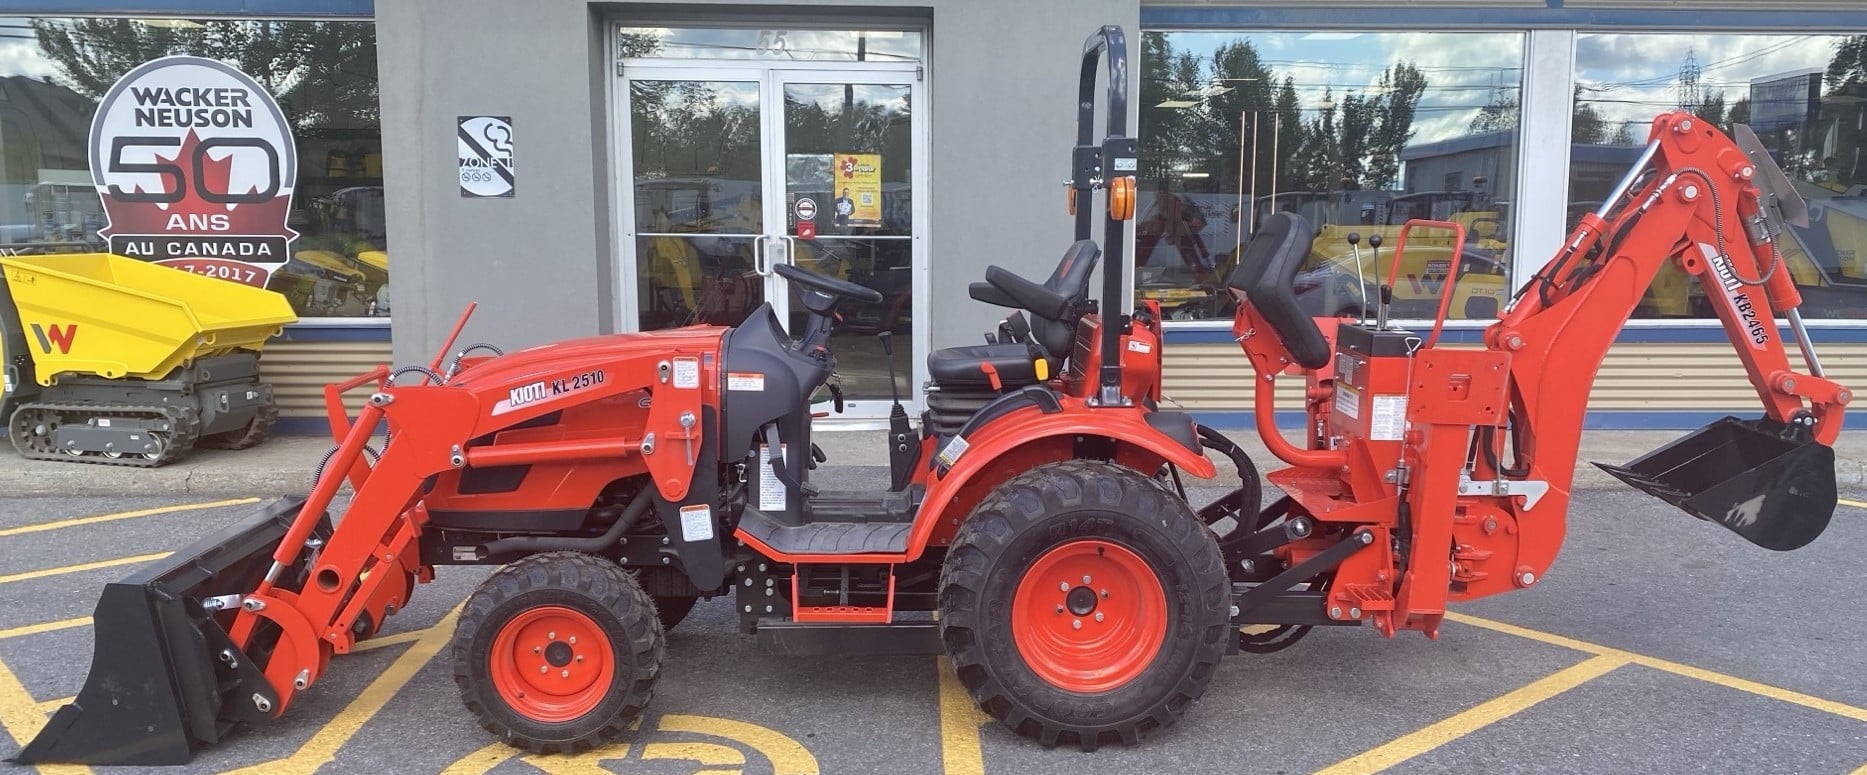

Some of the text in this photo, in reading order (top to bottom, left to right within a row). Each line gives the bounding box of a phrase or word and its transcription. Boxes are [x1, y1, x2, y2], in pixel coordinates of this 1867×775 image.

[756, 30, 787, 56] 55
[131, 87, 252, 107] WACKER
[134, 108, 253, 128] NEUSON
[108, 136, 280, 204] 50
[460, 156, 498, 169] ZONE
[166, 213, 230, 231] ANS
[125, 241, 272, 256] AU CANADA
[1733, 293, 1769, 345] KB2465
[509, 381, 546, 407] KIOTI
[571, 370, 605, 390] 2510
